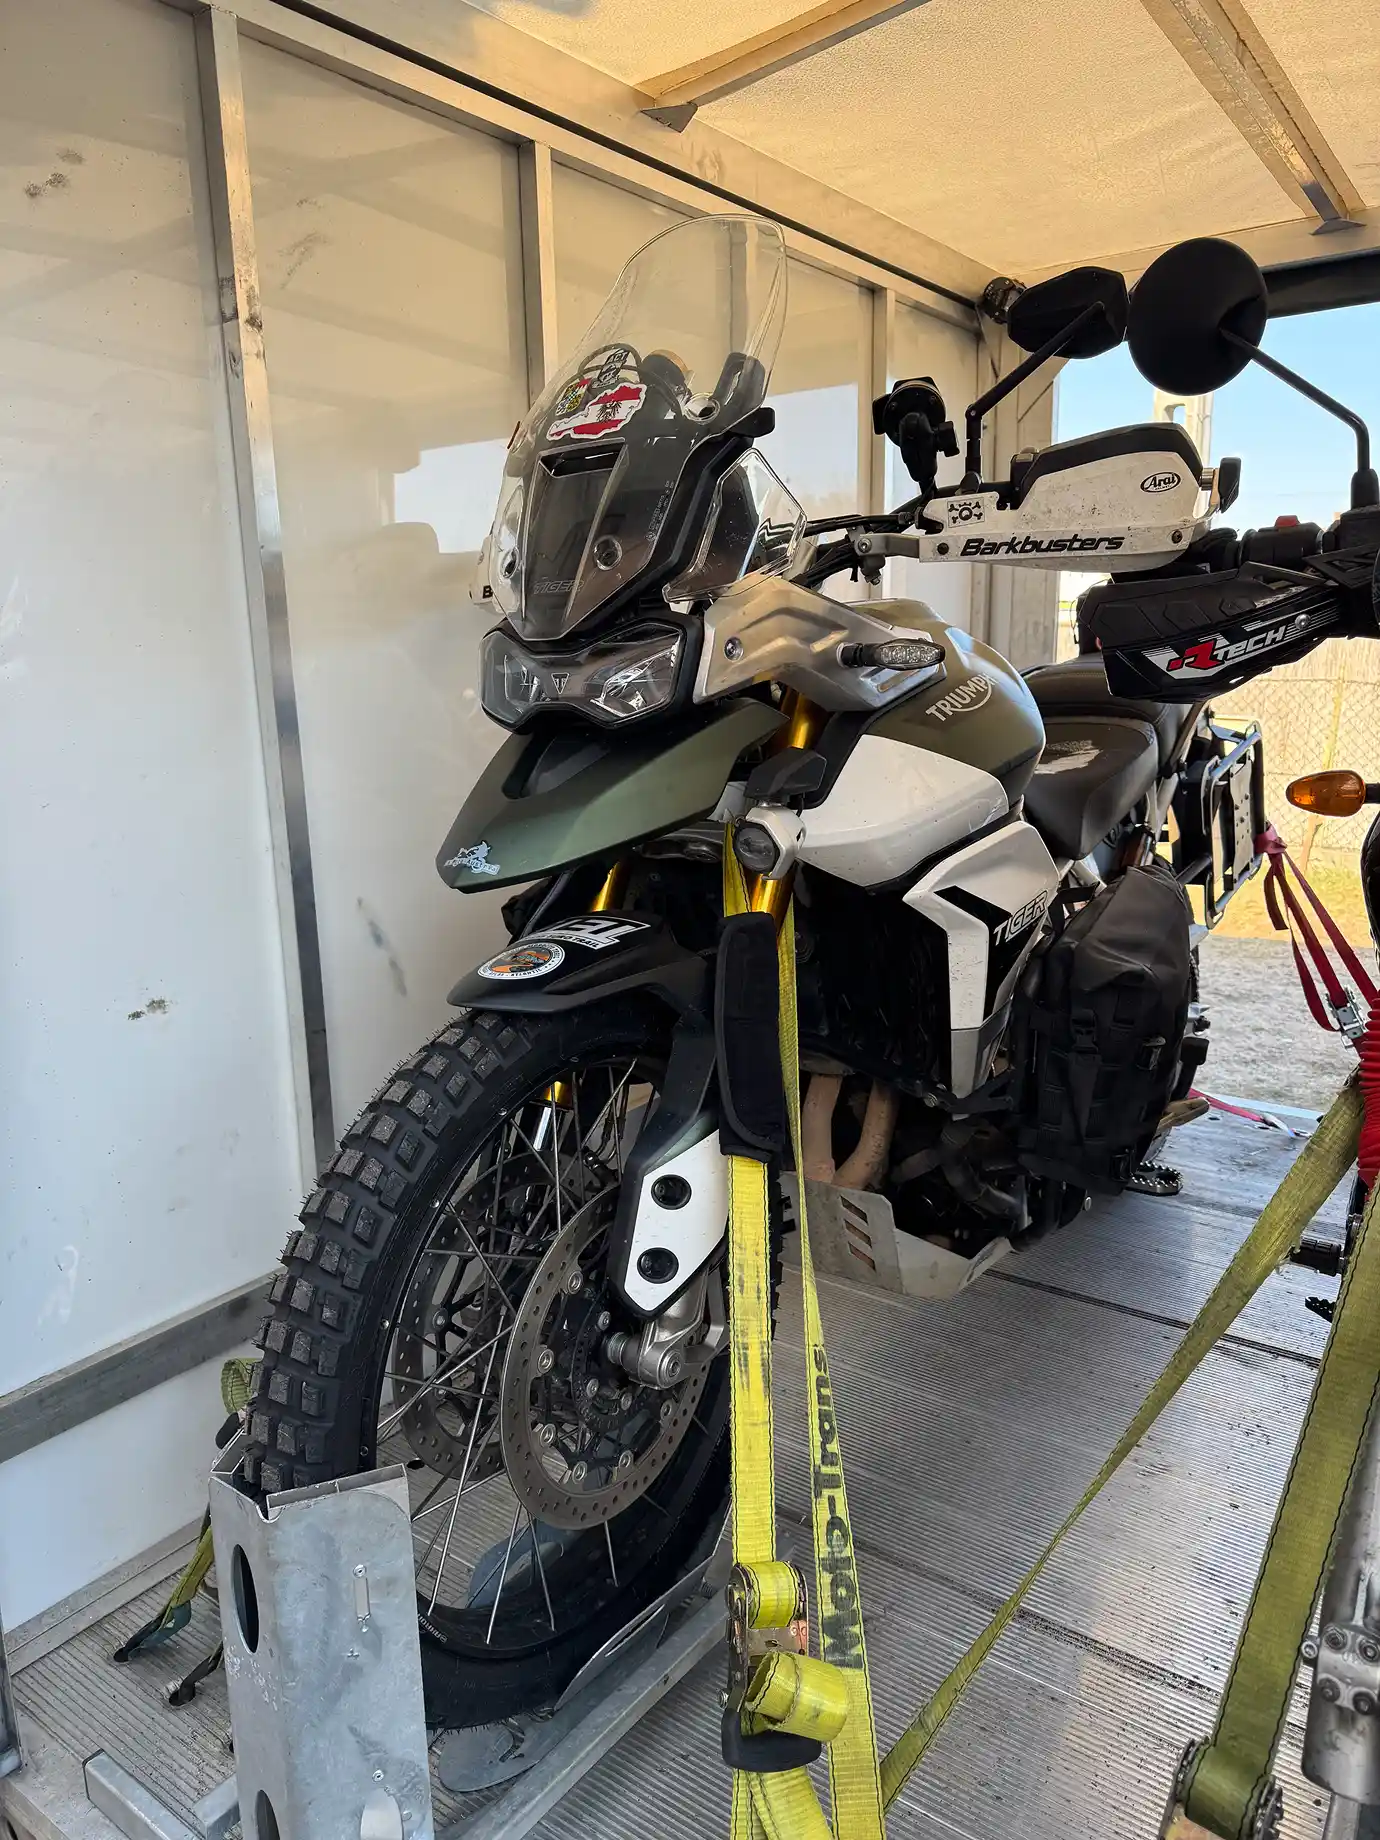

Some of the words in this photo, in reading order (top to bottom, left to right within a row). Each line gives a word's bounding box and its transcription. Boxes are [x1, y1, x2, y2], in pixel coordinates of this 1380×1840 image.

[1144, 473, 1176, 490] Arai
[960, 534, 1125, 556] Barkbusters
[533, 580, 584, 594] TIGER
[925, 672, 998, 721] TRIUMPH
[993, 890, 1048, 946] TIGER
